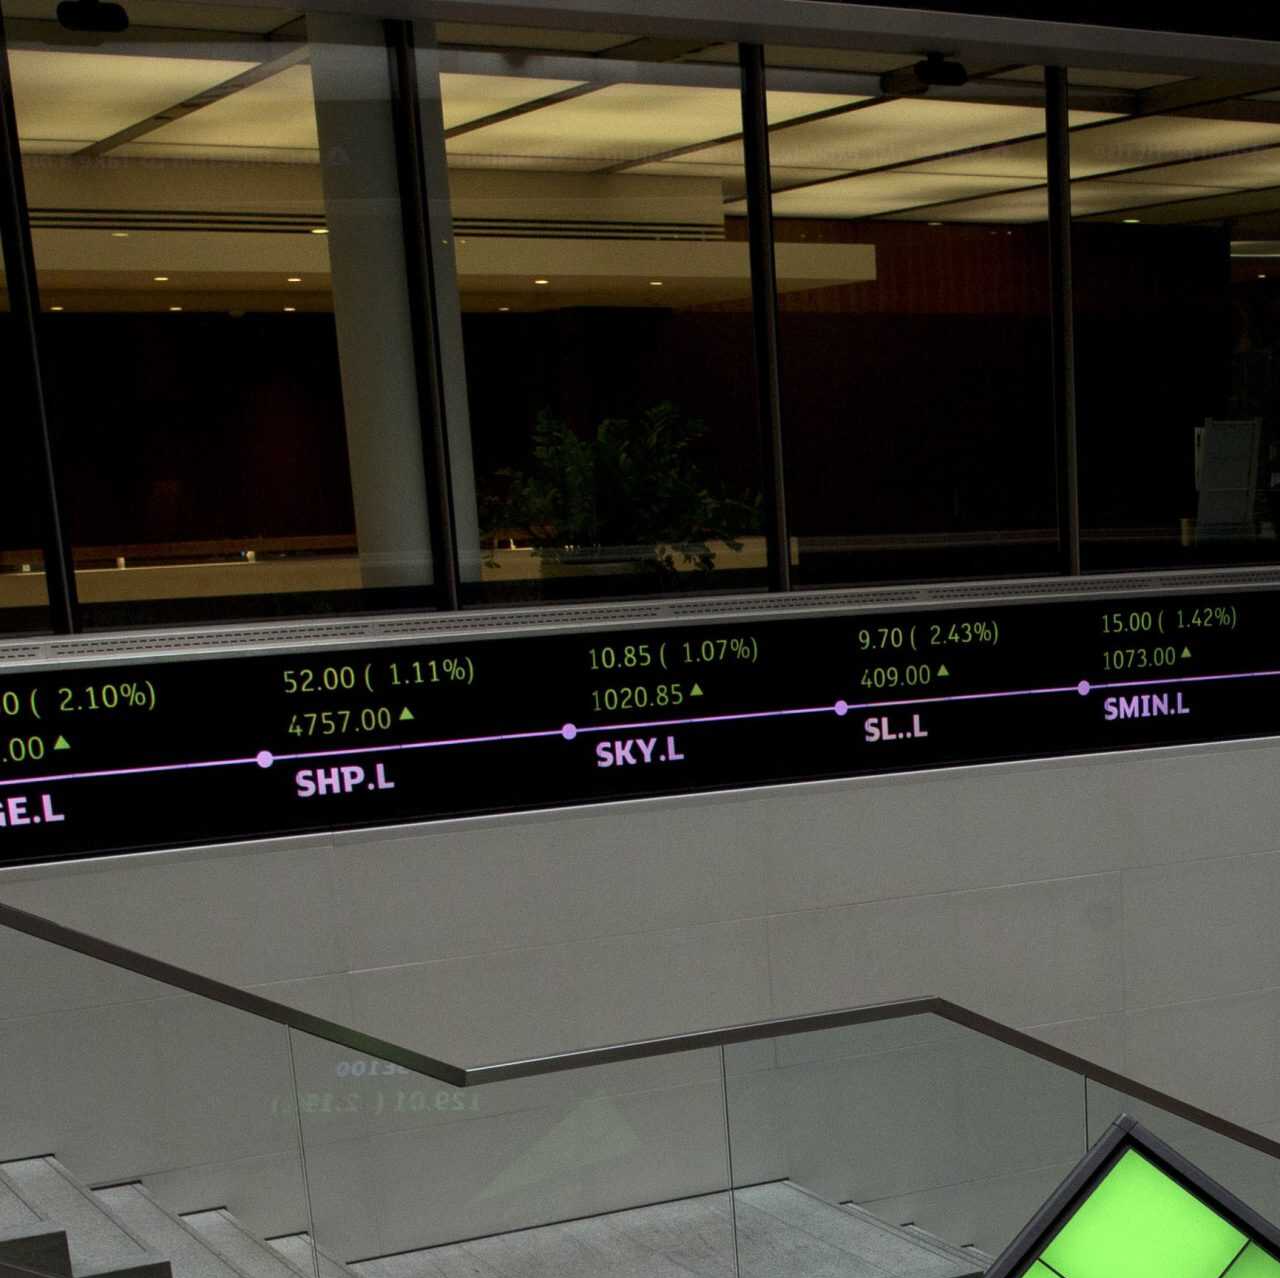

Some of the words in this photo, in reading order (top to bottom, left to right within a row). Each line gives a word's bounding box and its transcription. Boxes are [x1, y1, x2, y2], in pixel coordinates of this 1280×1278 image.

[1102, 611, 1152, 634] 15.00
[1177, 605, 1237, 631] 1.42%)
[858, 627, 903, 650] 9.70
[929, 620, 1000, 646] 2.43%)
[589, 645, 651, 670] 10.85
[683, 636, 759, 664] 1.07%)
[1103, 646, 1176, 671] 1073.00
[283, 666, 356, 694] 52.00
[390, 657, 476, 686] 1.11%)
[860, 664, 931, 689] 409.00
[58, 681, 157, 712] 2.10%)
[592, 683, 684, 712] 1020.85
[1104, 692, 1190, 721] SMIN.L
[288, 707, 391, 737] 4757.00
[864, 714, 928, 743] SL..L
[595, 736, 685, 768] SKY.L
[296, 763, 395, 798] SHP.L
[0, 794, 65, 829] E.L
